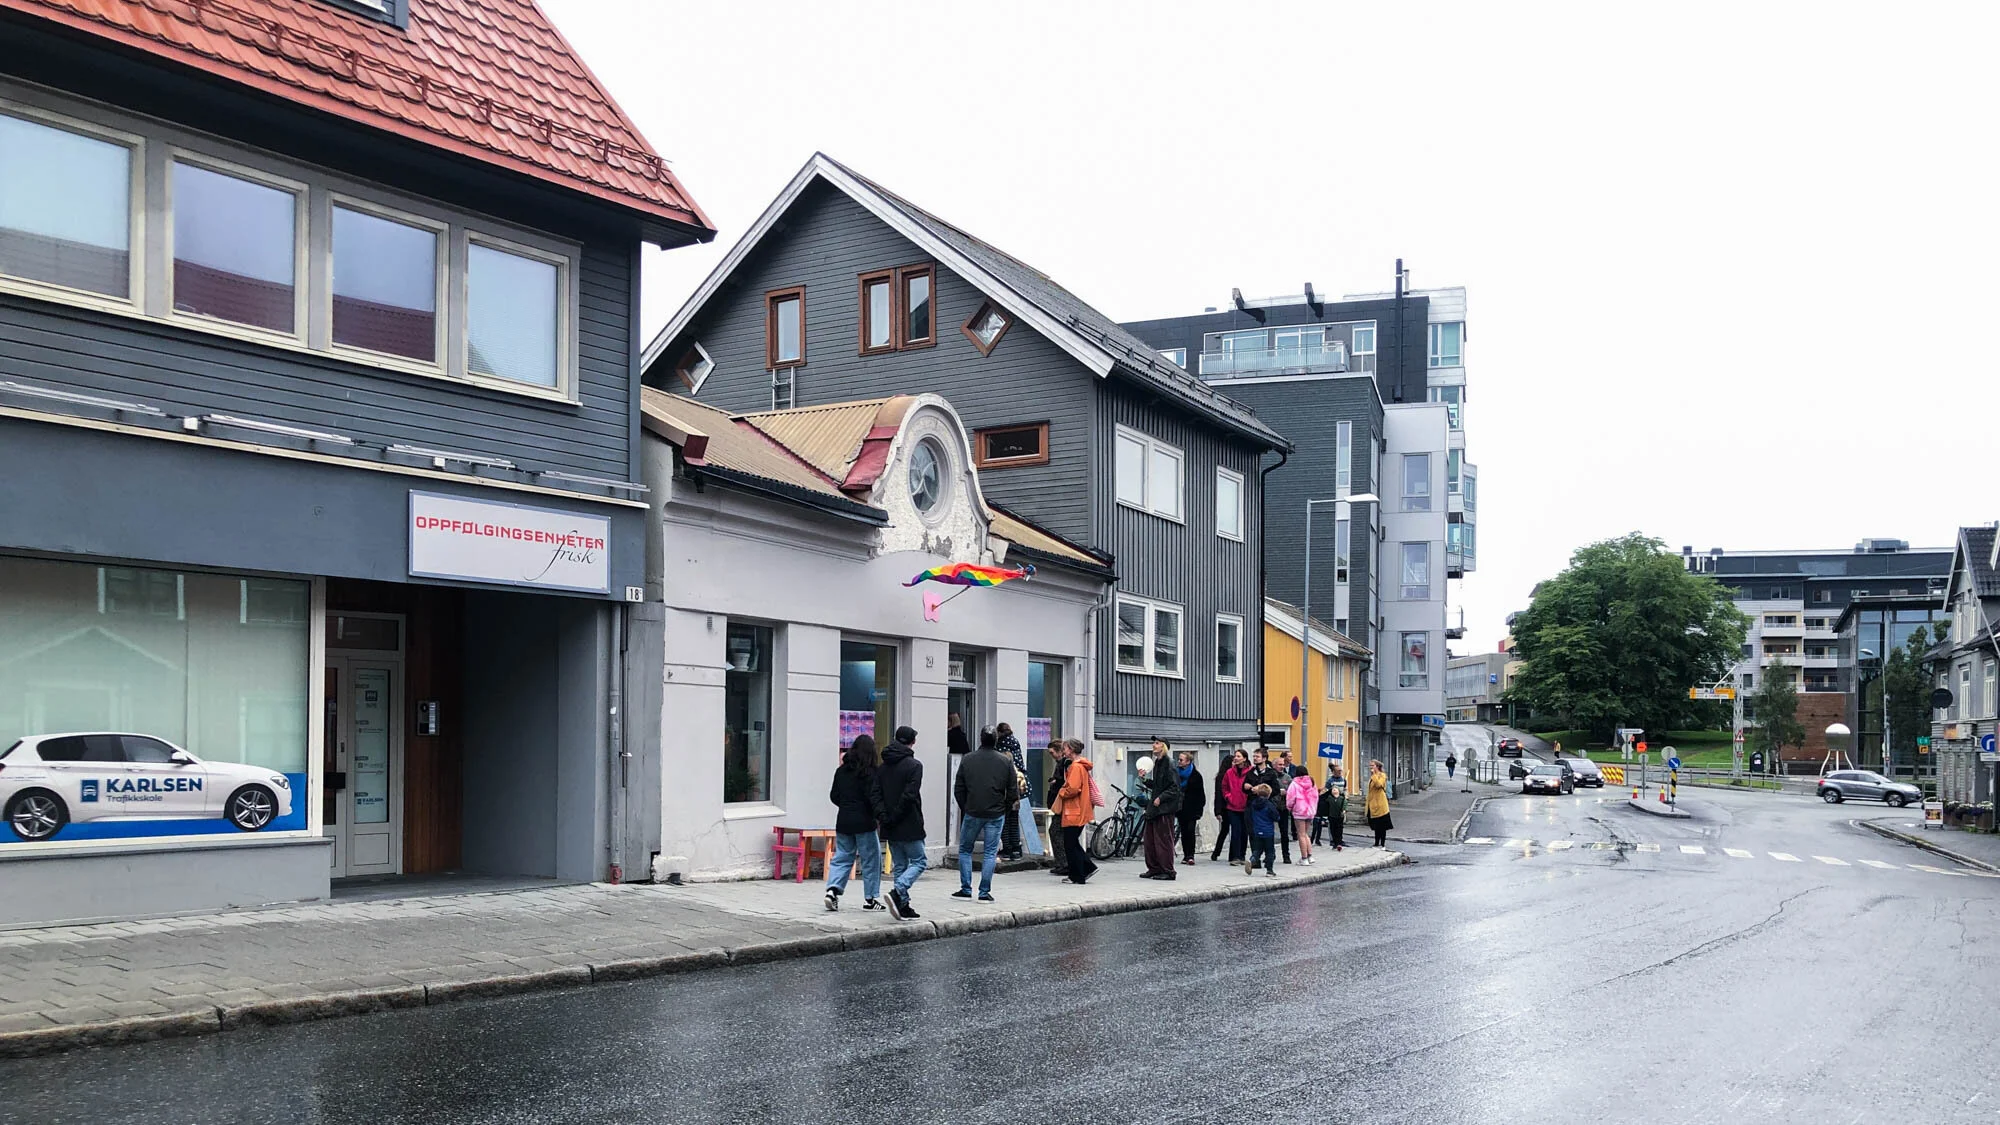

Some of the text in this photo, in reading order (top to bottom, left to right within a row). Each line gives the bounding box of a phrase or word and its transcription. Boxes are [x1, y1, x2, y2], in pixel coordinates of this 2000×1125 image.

[416, 516, 604, 550] OPPFØLGINGSENHETEN
[523, 530, 597, 581] frisk
[106, 777, 203, 793] KARLSEN
[106, 794, 163, 804] Trafikkskole
